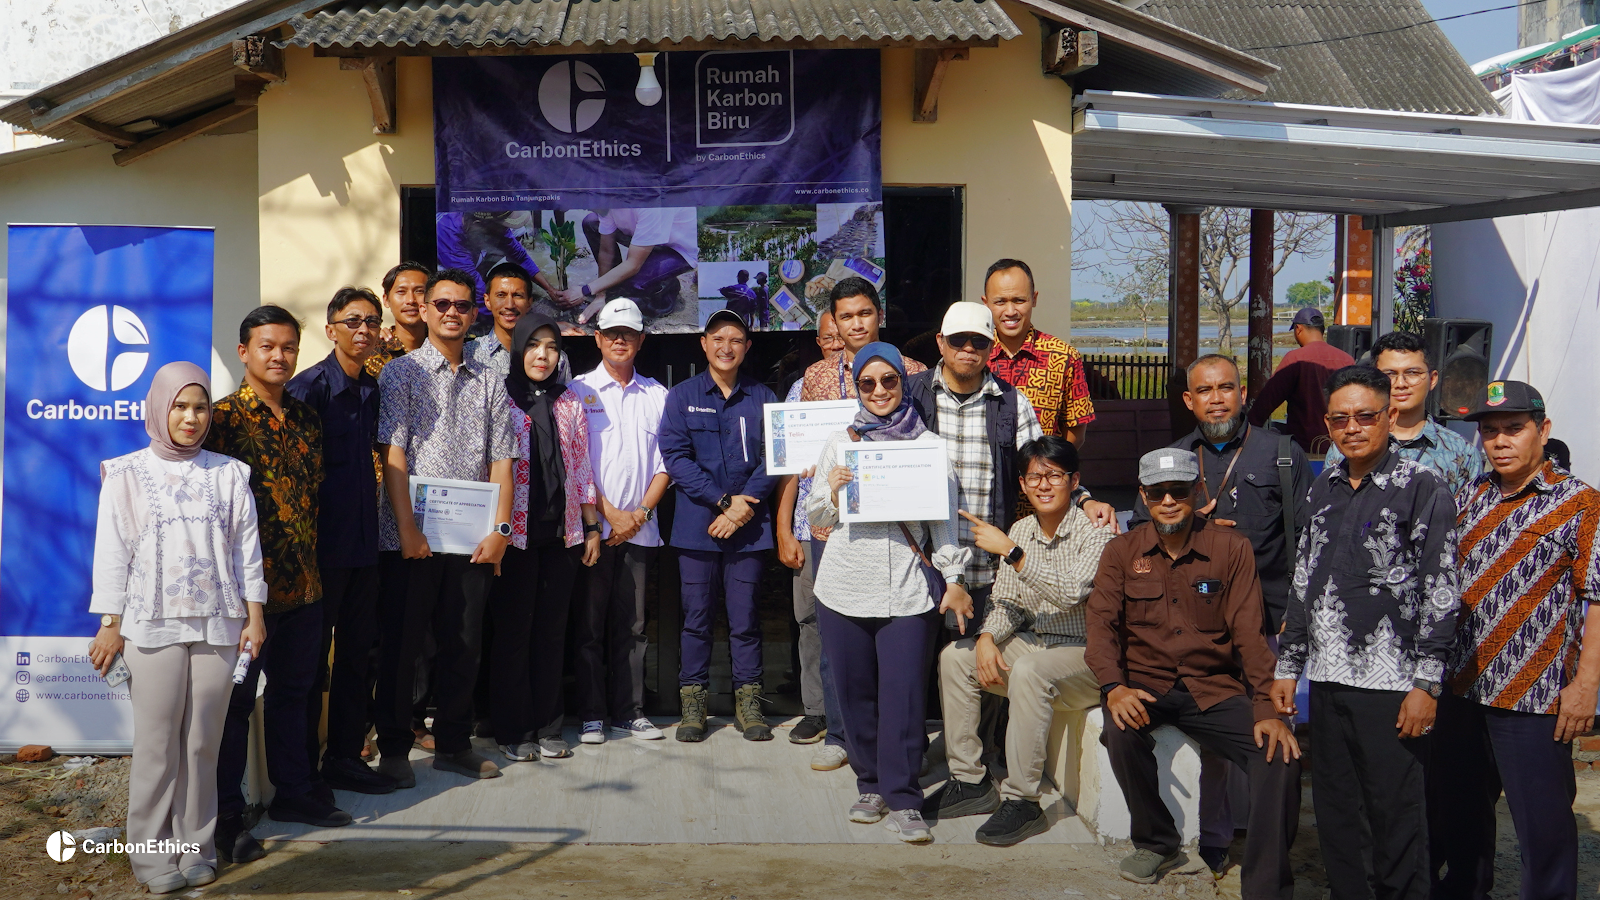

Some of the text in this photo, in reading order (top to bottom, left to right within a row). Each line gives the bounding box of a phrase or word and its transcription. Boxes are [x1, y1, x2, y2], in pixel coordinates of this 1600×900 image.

[706, 65, 780, 84] Rumah
[707, 88, 783, 107] Karbon
[707, 111, 750, 130] Biru
[505, 140, 642, 158] CarbonEthics
[696, 152, 766, 162] by CarbonEthics
[794, 187, 869, 195] www.carbonethics.co
[516, 194, 561, 202] Tanjungpakis
[26, 398, 146, 420] CarbonEt
[36, 653, 92, 664] CarbonEth
[36, 673, 107, 683] @carbonethic
[36, 691, 131, 701] www.carbonethics
